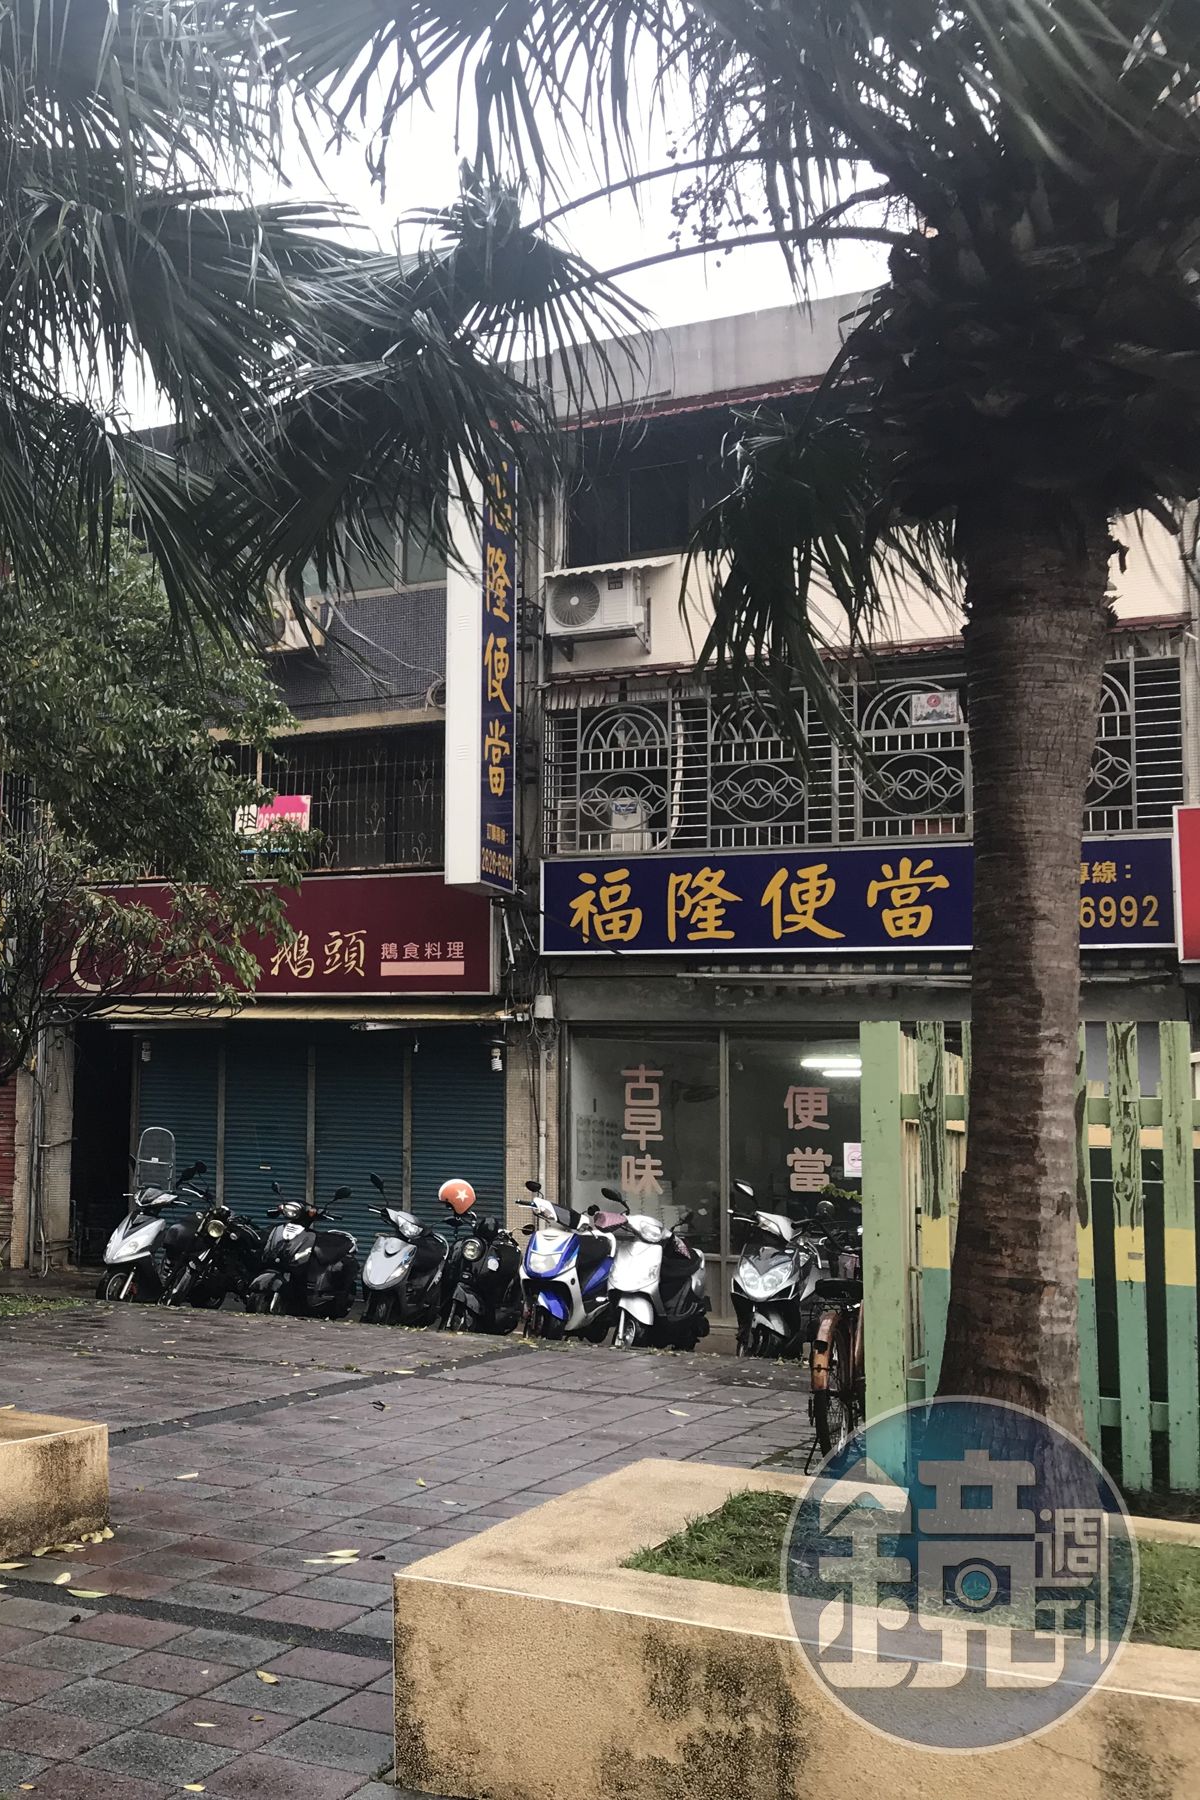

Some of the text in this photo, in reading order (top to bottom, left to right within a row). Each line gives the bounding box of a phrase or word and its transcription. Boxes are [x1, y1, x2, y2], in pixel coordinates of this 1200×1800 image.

[569, 857, 950, 943] 福隆便當
[1080, 895, 1159, 928] 6992
[381, 941, 465, 960] 鵝食料理
[620, 1064, 664, 1195] 古早味
[783, 1085, 833, 1192] 便當
